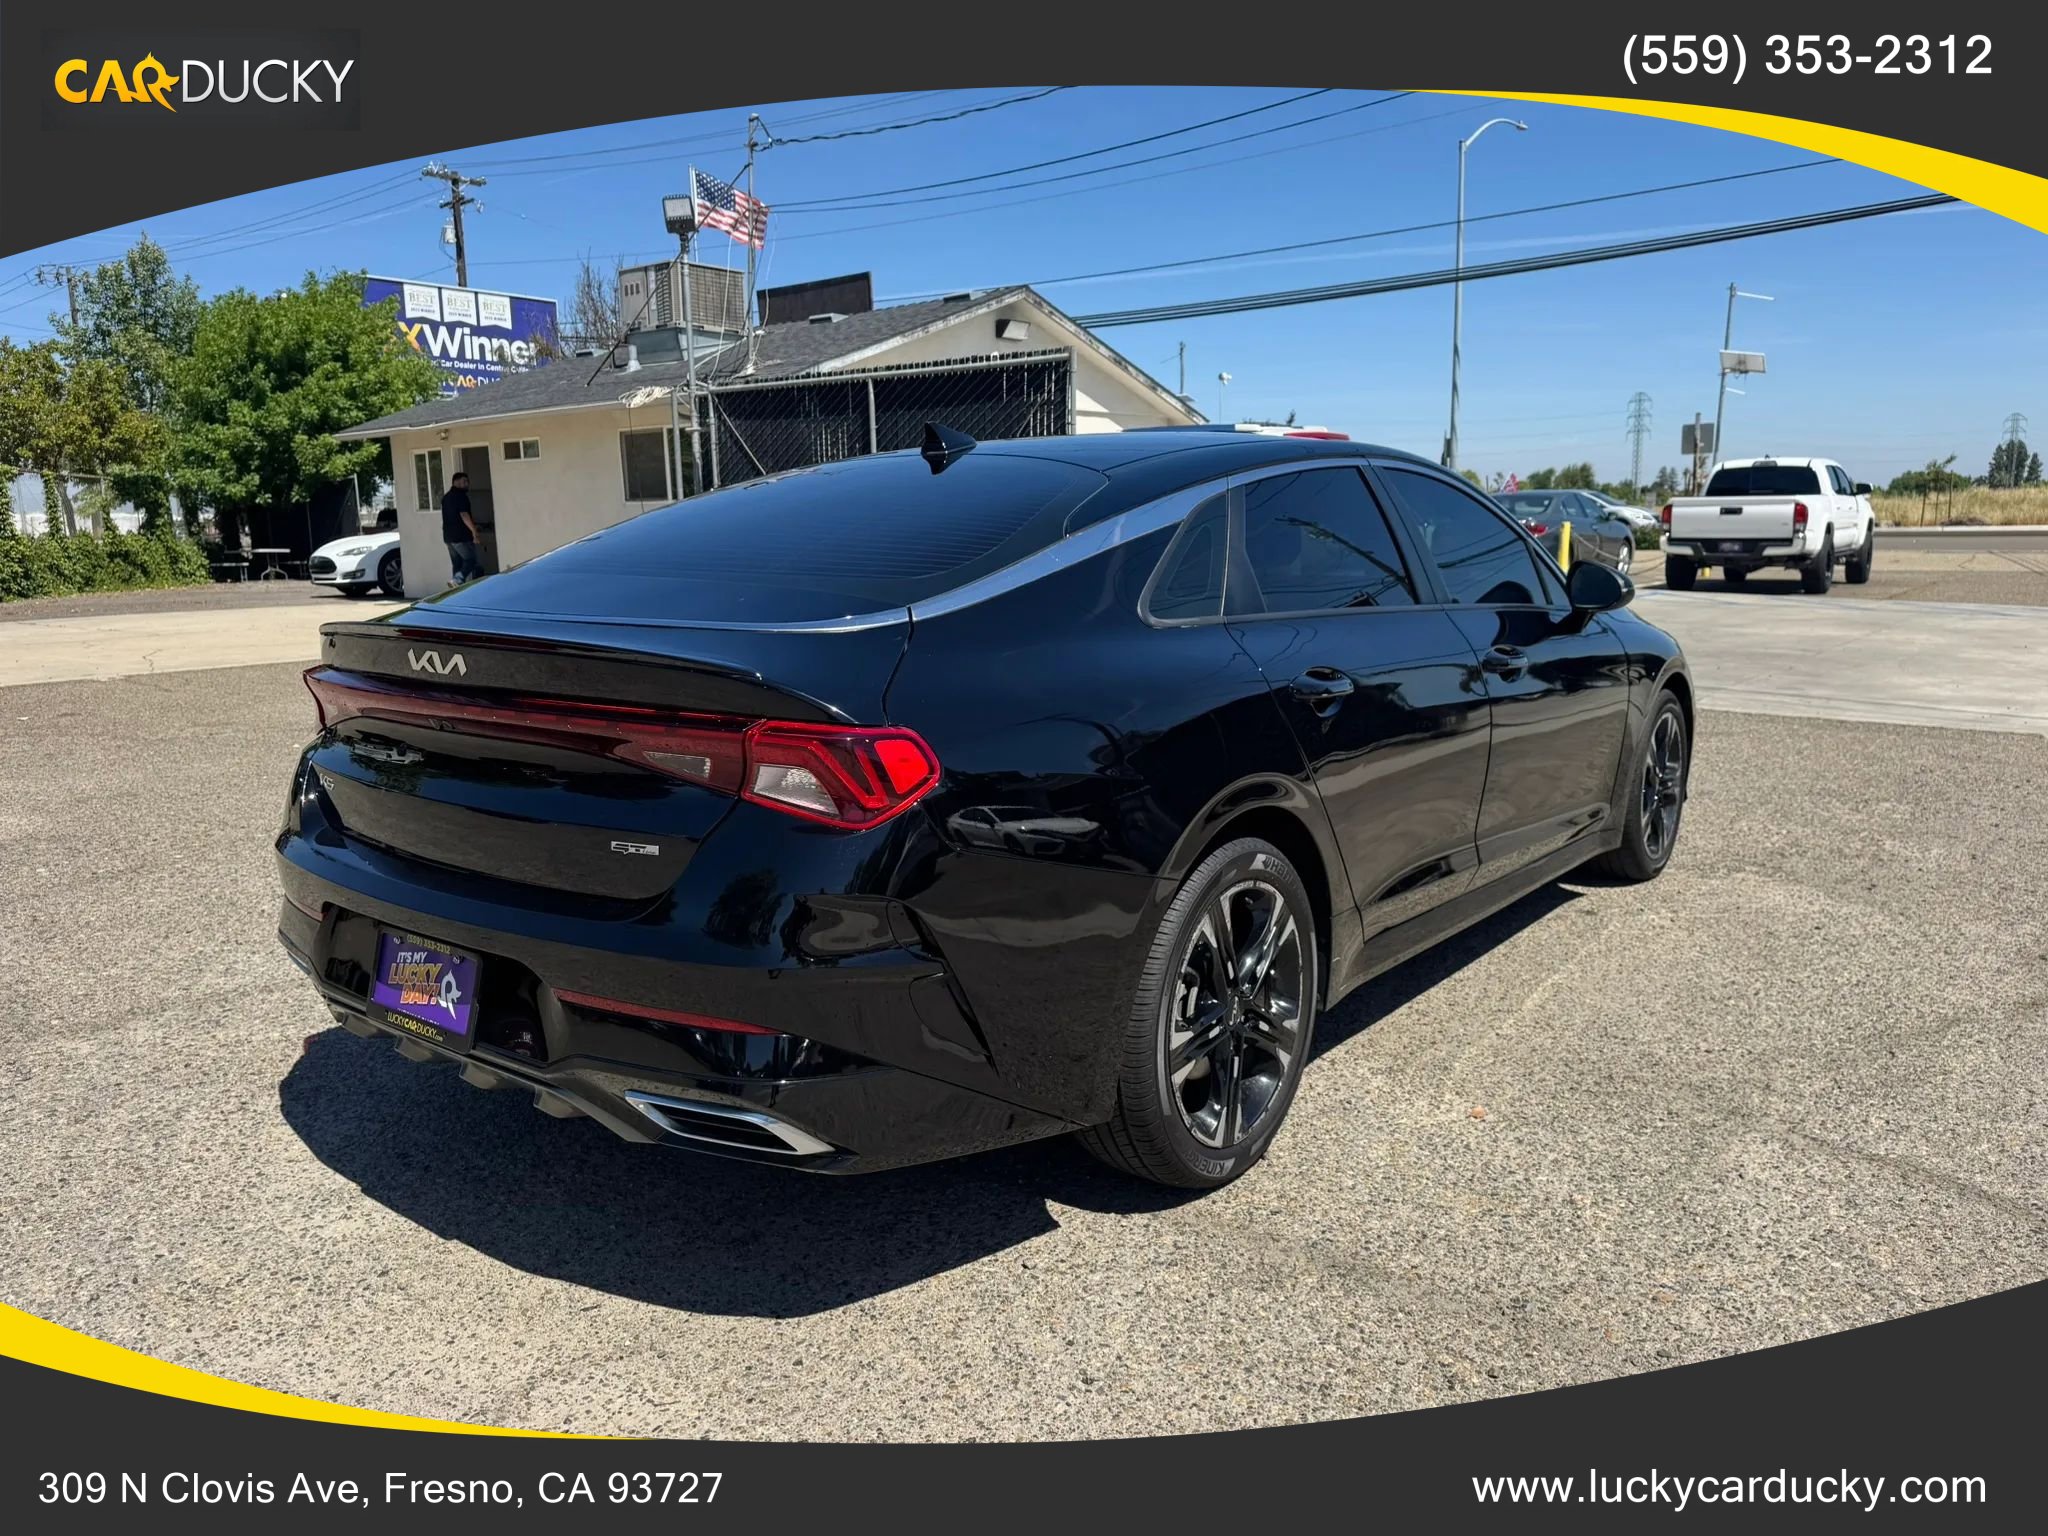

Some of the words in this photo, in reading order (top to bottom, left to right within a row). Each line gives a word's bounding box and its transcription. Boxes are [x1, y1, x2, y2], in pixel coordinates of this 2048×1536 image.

[454, 361, 476, 369] Dealer
[408, 648, 467, 677] KIA
[397, 951, 412, 963] IT'S
[412, 951, 427, 963] MY
[388, 963, 442, 984] LUCKY
[400, 983, 440, 1005] DAY!
